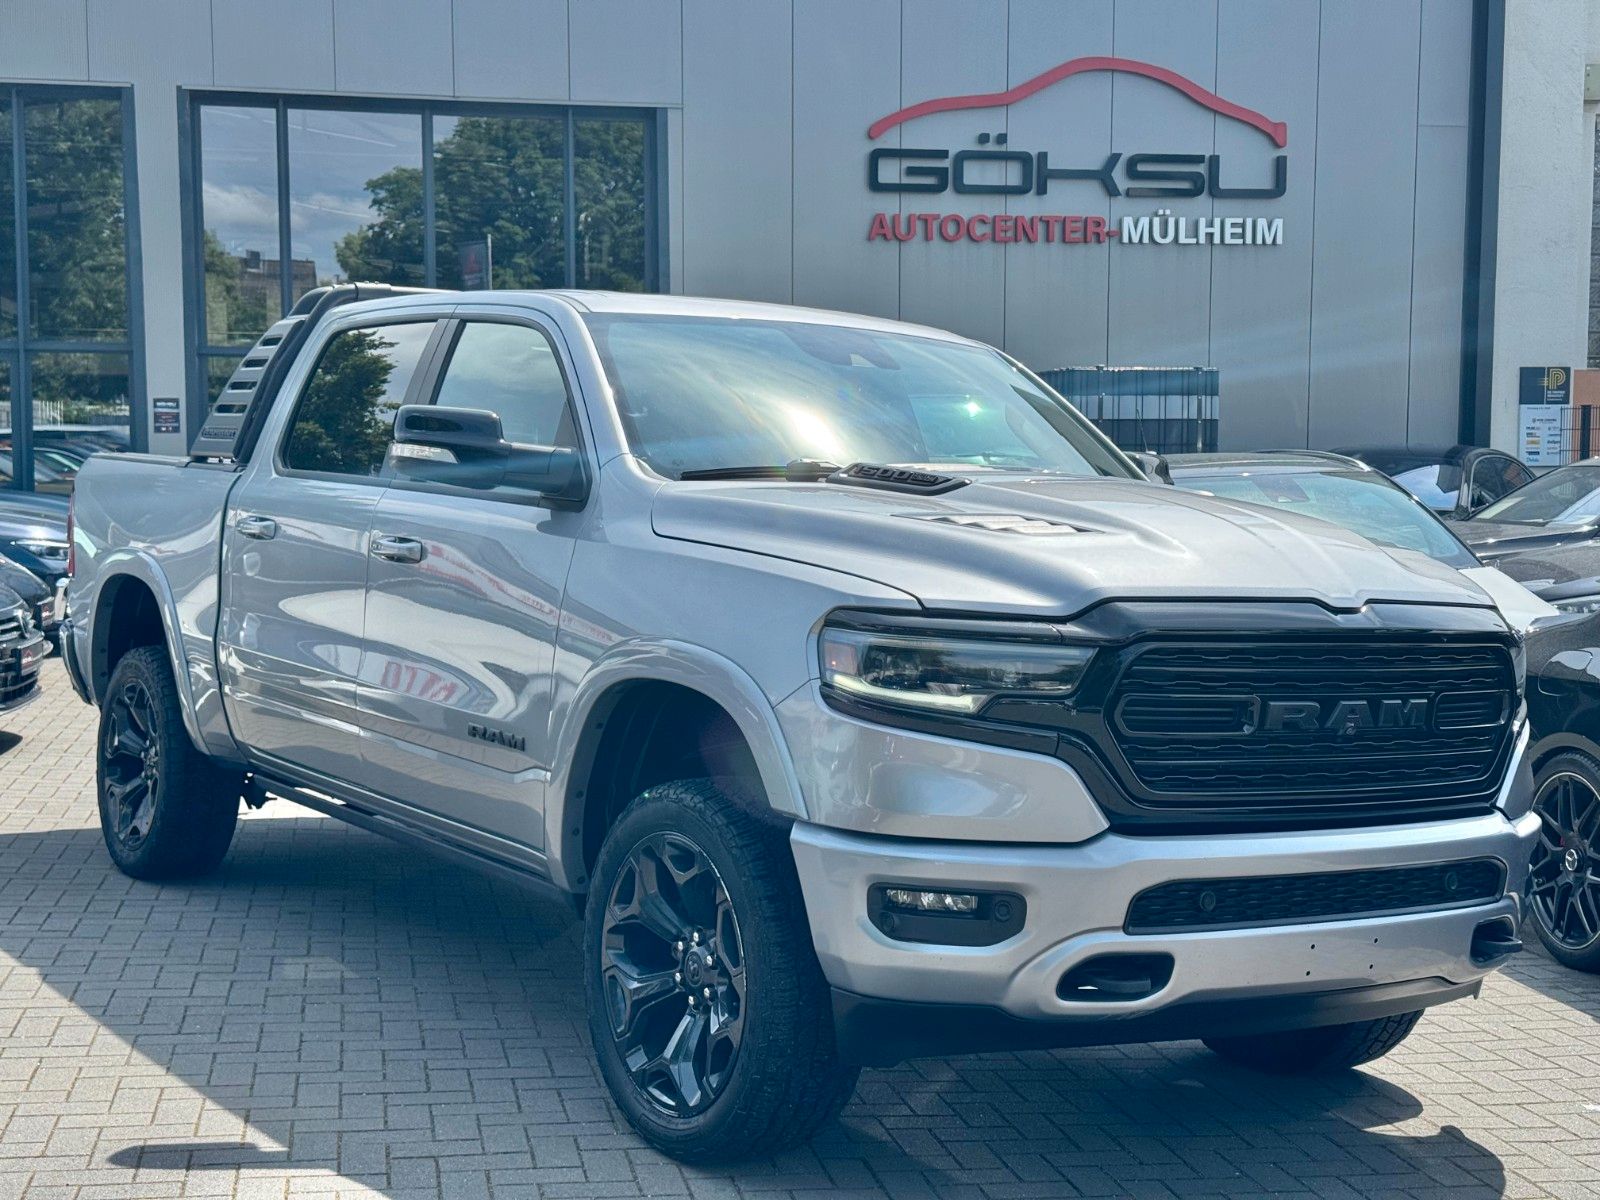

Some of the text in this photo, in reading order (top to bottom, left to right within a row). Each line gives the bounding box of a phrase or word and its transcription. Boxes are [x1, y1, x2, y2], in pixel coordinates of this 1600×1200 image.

[868, 133, 1288, 199] GÖKSU
[868, 209, 1284, 245] AUTOCENTER-MÜLHEIM
[1264, 698, 1429, 731] RAM
[467, 722, 526, 752] RAM
